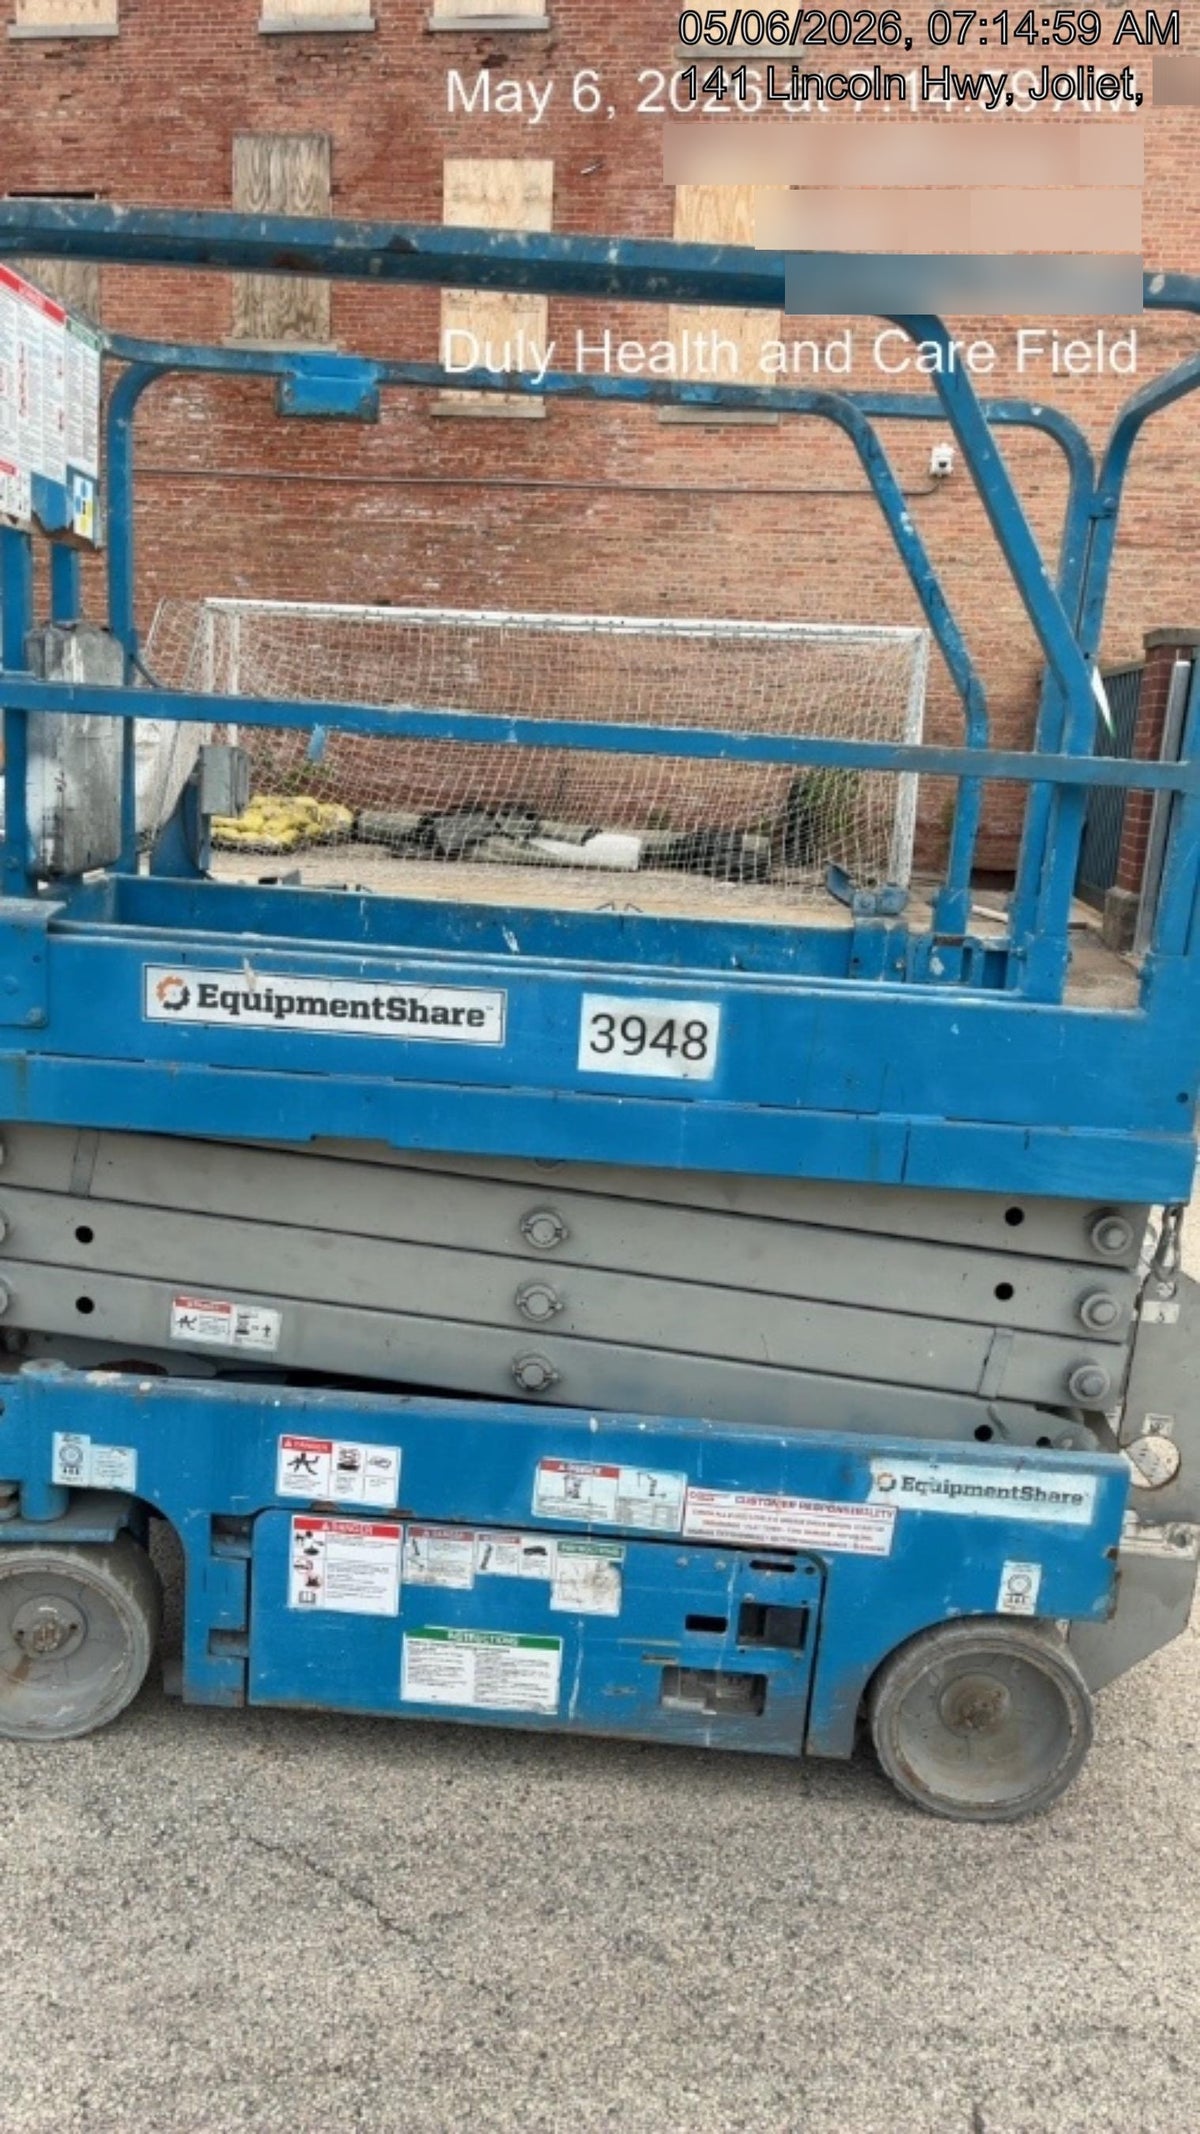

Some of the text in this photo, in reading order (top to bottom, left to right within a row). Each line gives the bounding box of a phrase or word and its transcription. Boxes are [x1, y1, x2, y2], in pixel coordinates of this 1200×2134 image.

[196, 982, 486, 1029] EquipmentShare
[588, 1012, 709, 1061] 3948
[901, 1475, 1085, 1507] EquipmentShare
